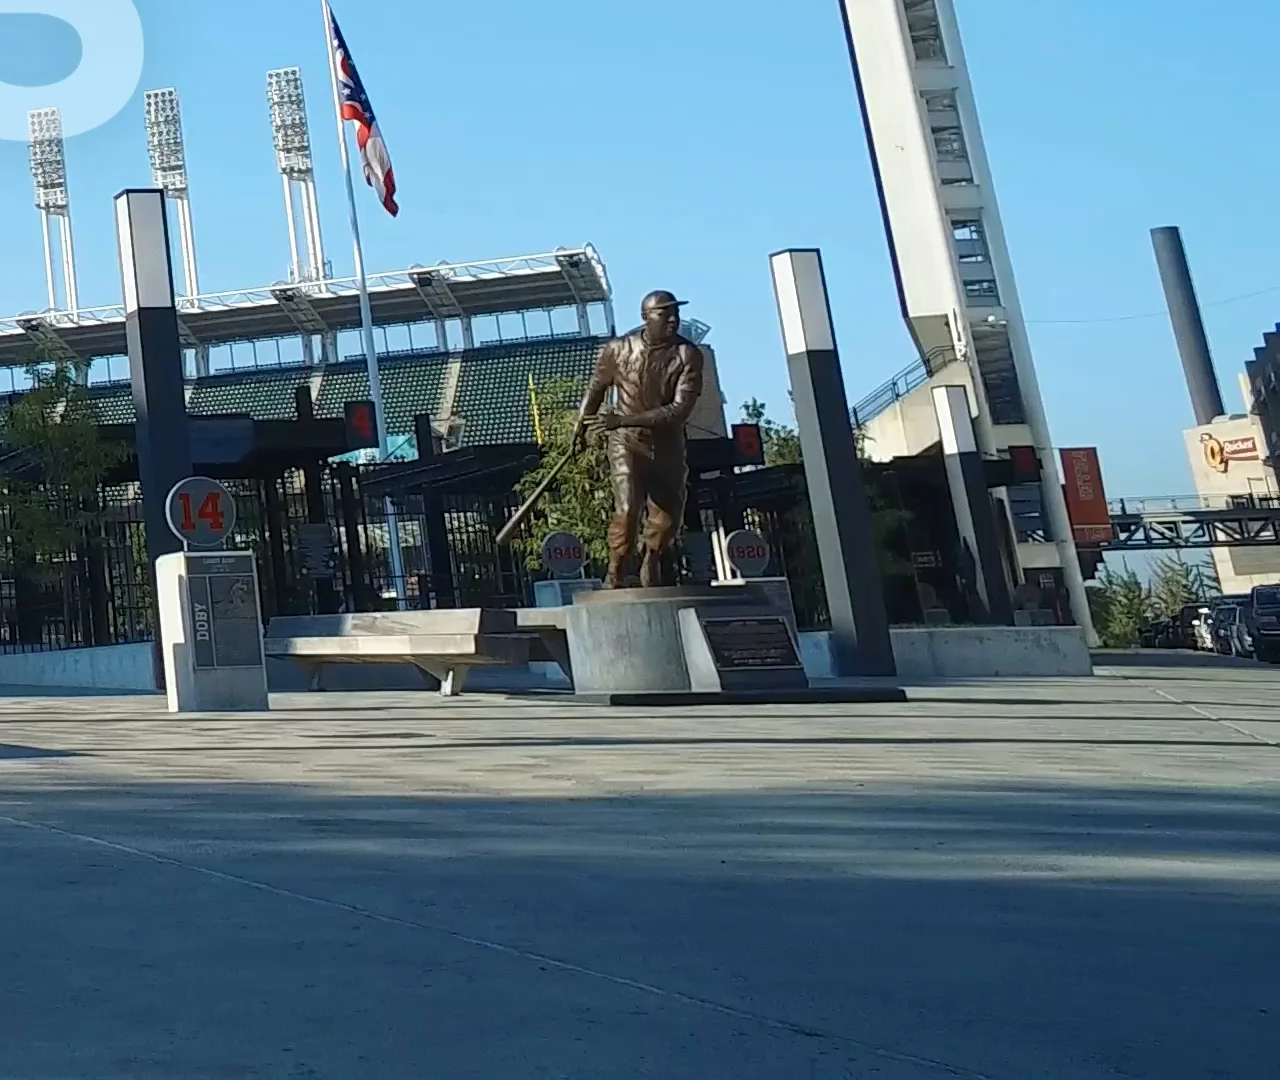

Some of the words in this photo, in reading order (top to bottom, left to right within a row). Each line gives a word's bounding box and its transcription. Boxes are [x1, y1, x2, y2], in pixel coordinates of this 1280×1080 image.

[351, 405, 372, 438] 4
[178, 492, 224, 531] 14
[196, 603, 209, 641] DOBY
